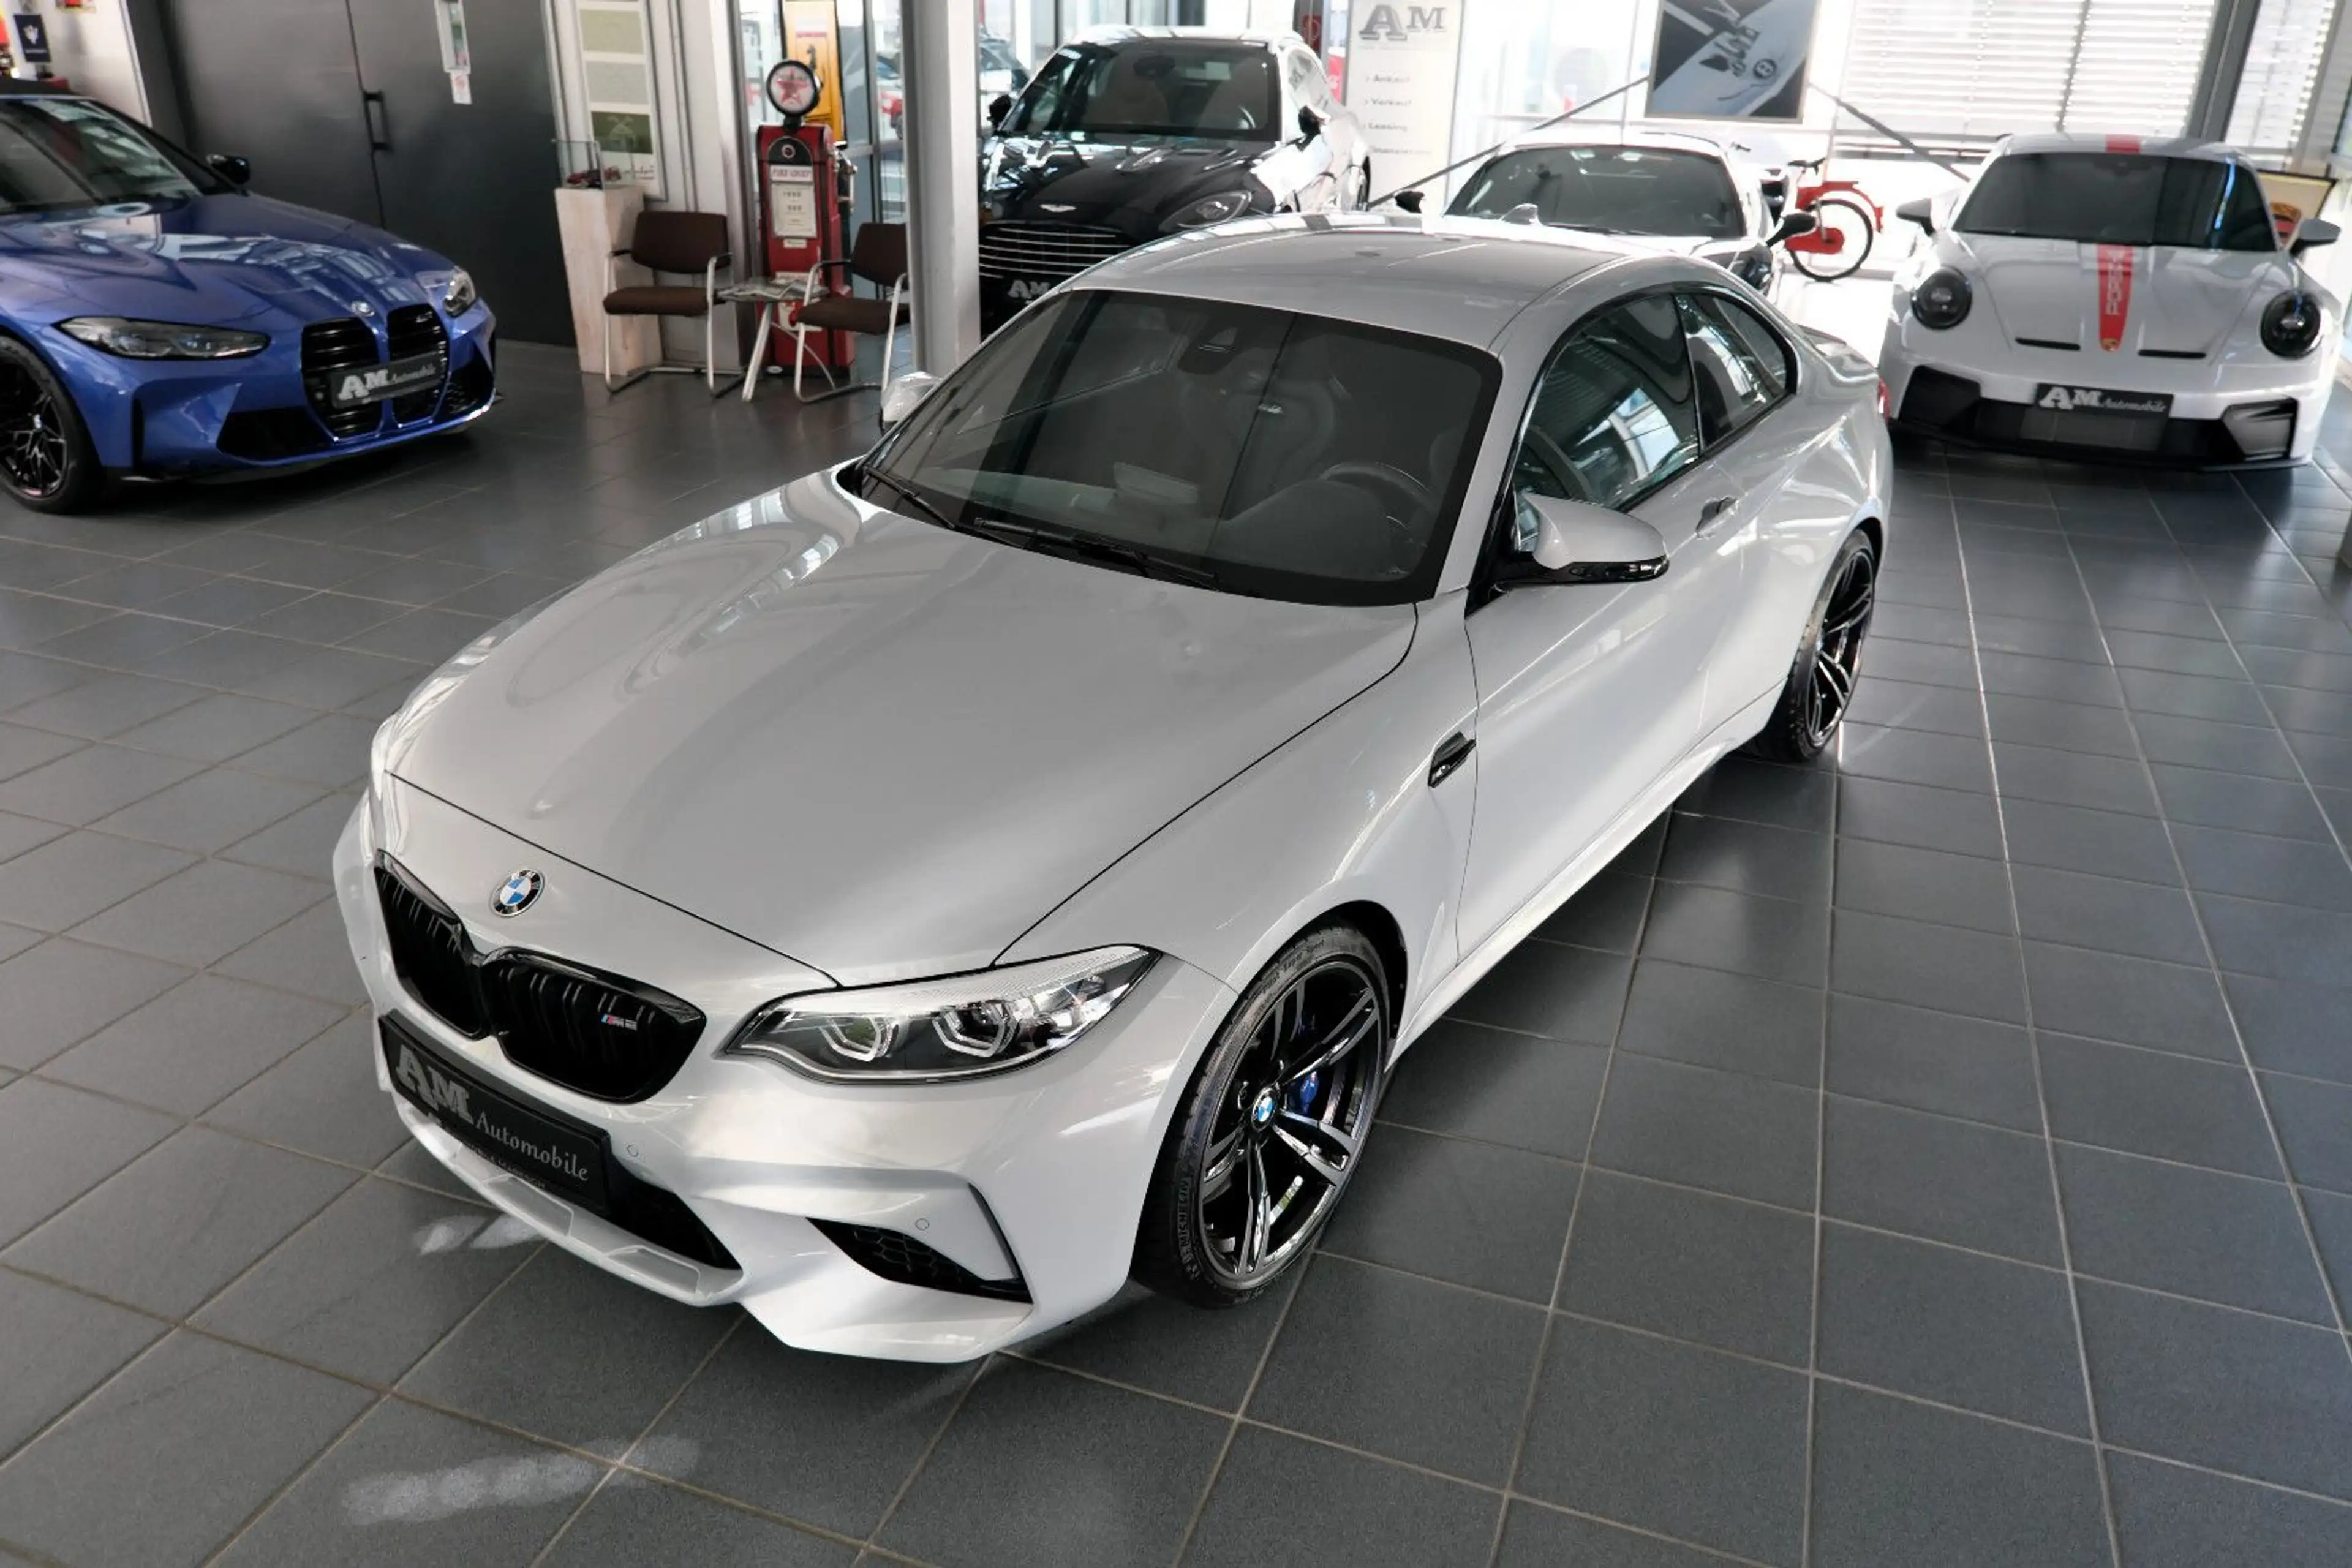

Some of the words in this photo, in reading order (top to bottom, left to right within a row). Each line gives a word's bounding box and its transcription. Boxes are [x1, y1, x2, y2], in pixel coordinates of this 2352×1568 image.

[1358, 4, 1447, 41] AM
[1368, 122, 1409, 132] Leasing
[1007, 279, 1050, 299] AM
[338, 369, 388, 401] AM
[2039, 386, 2102, 410] AM
[395, 1044, 473, 1125] AM
[475, 1110, 588, 1182] Automobile
